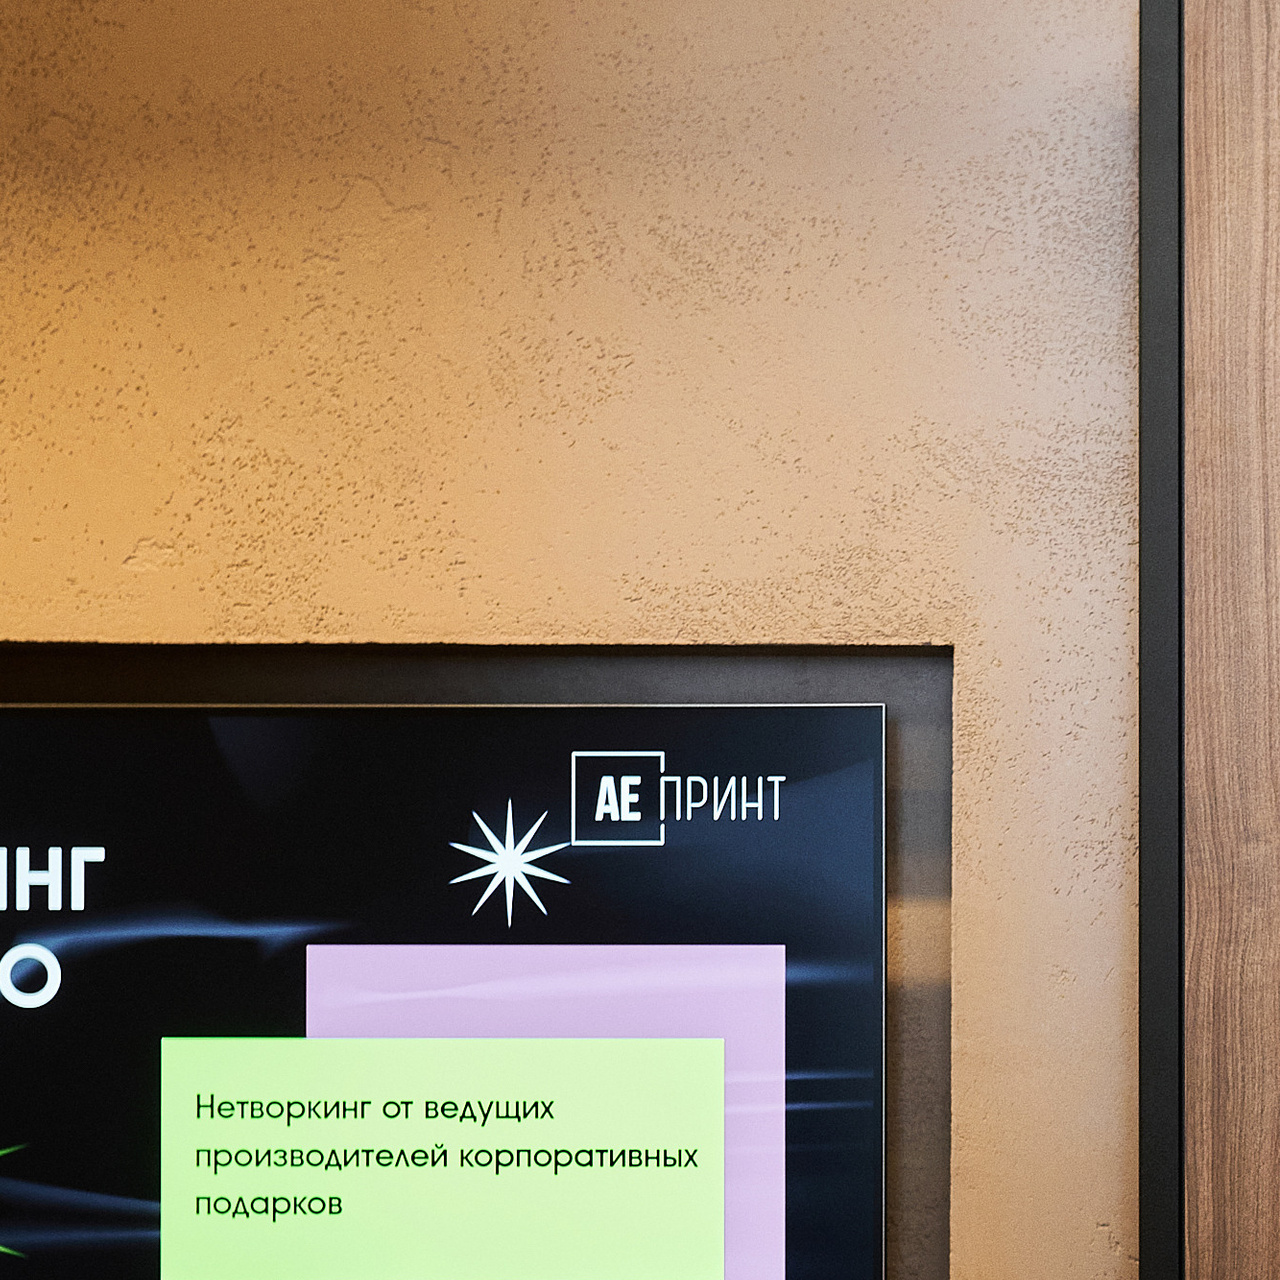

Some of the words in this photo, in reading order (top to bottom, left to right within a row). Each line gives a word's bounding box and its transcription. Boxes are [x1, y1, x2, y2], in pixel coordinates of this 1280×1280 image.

[659, 775, 787, 821] ПРИНТ
[196, 1093, 372, 1127] Нетворкинг
[382, 1100, 414, 1120] от
[425, 1100, 555, 1128] ведущих
[196, 1143, 448, 1175] производителей
[460, 1148, 698, 1176] корпоративных
[195, 1196, 343, 1223] подарков
